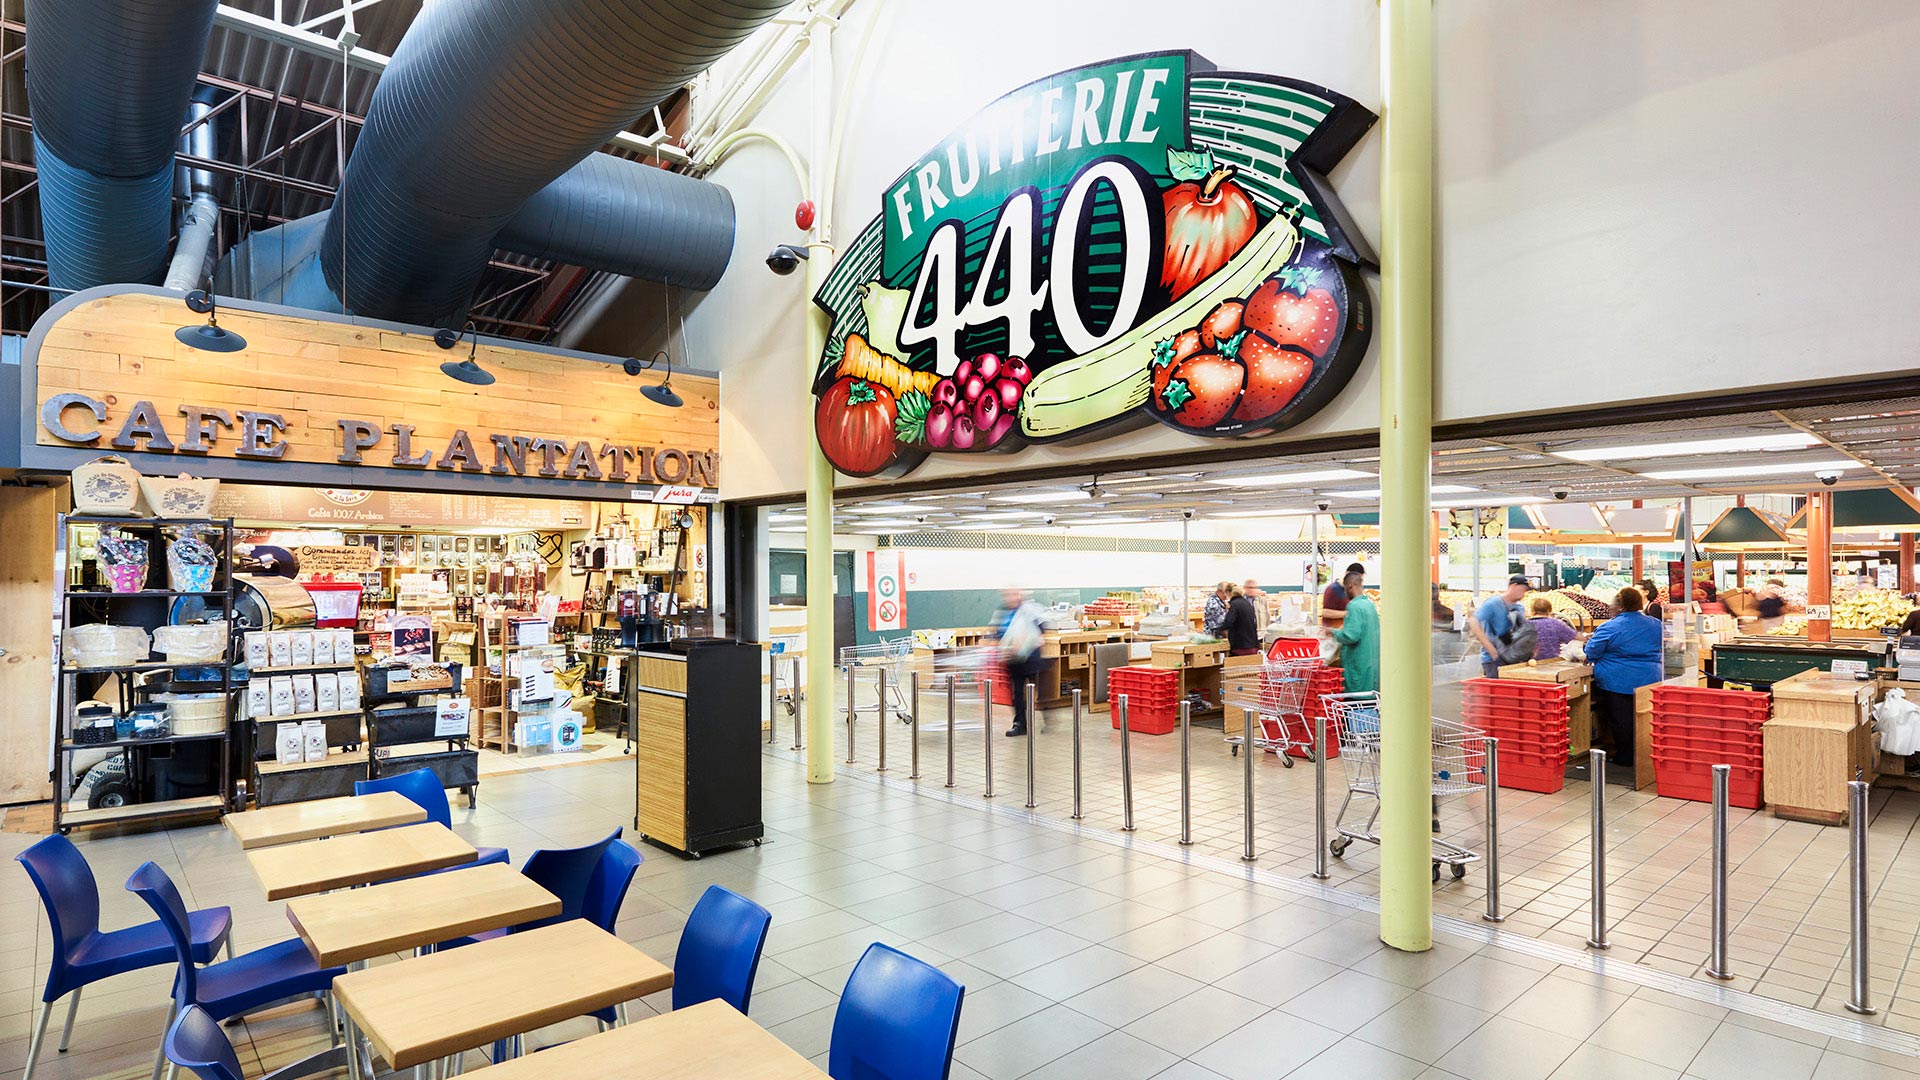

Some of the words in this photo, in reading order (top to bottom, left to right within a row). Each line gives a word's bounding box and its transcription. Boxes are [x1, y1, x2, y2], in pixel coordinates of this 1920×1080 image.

[893, 68, 1168, 241] FRUITERIE
[900, 161, 1152, 375] 440
[41, 393, 289, 459] CAFE
[337, 419, 719, 486] PLANTATION
[333, 508, 354, 519] 100%
[354, 509, 384, 520] Arabica
[663, 488, 693, 501] jura
